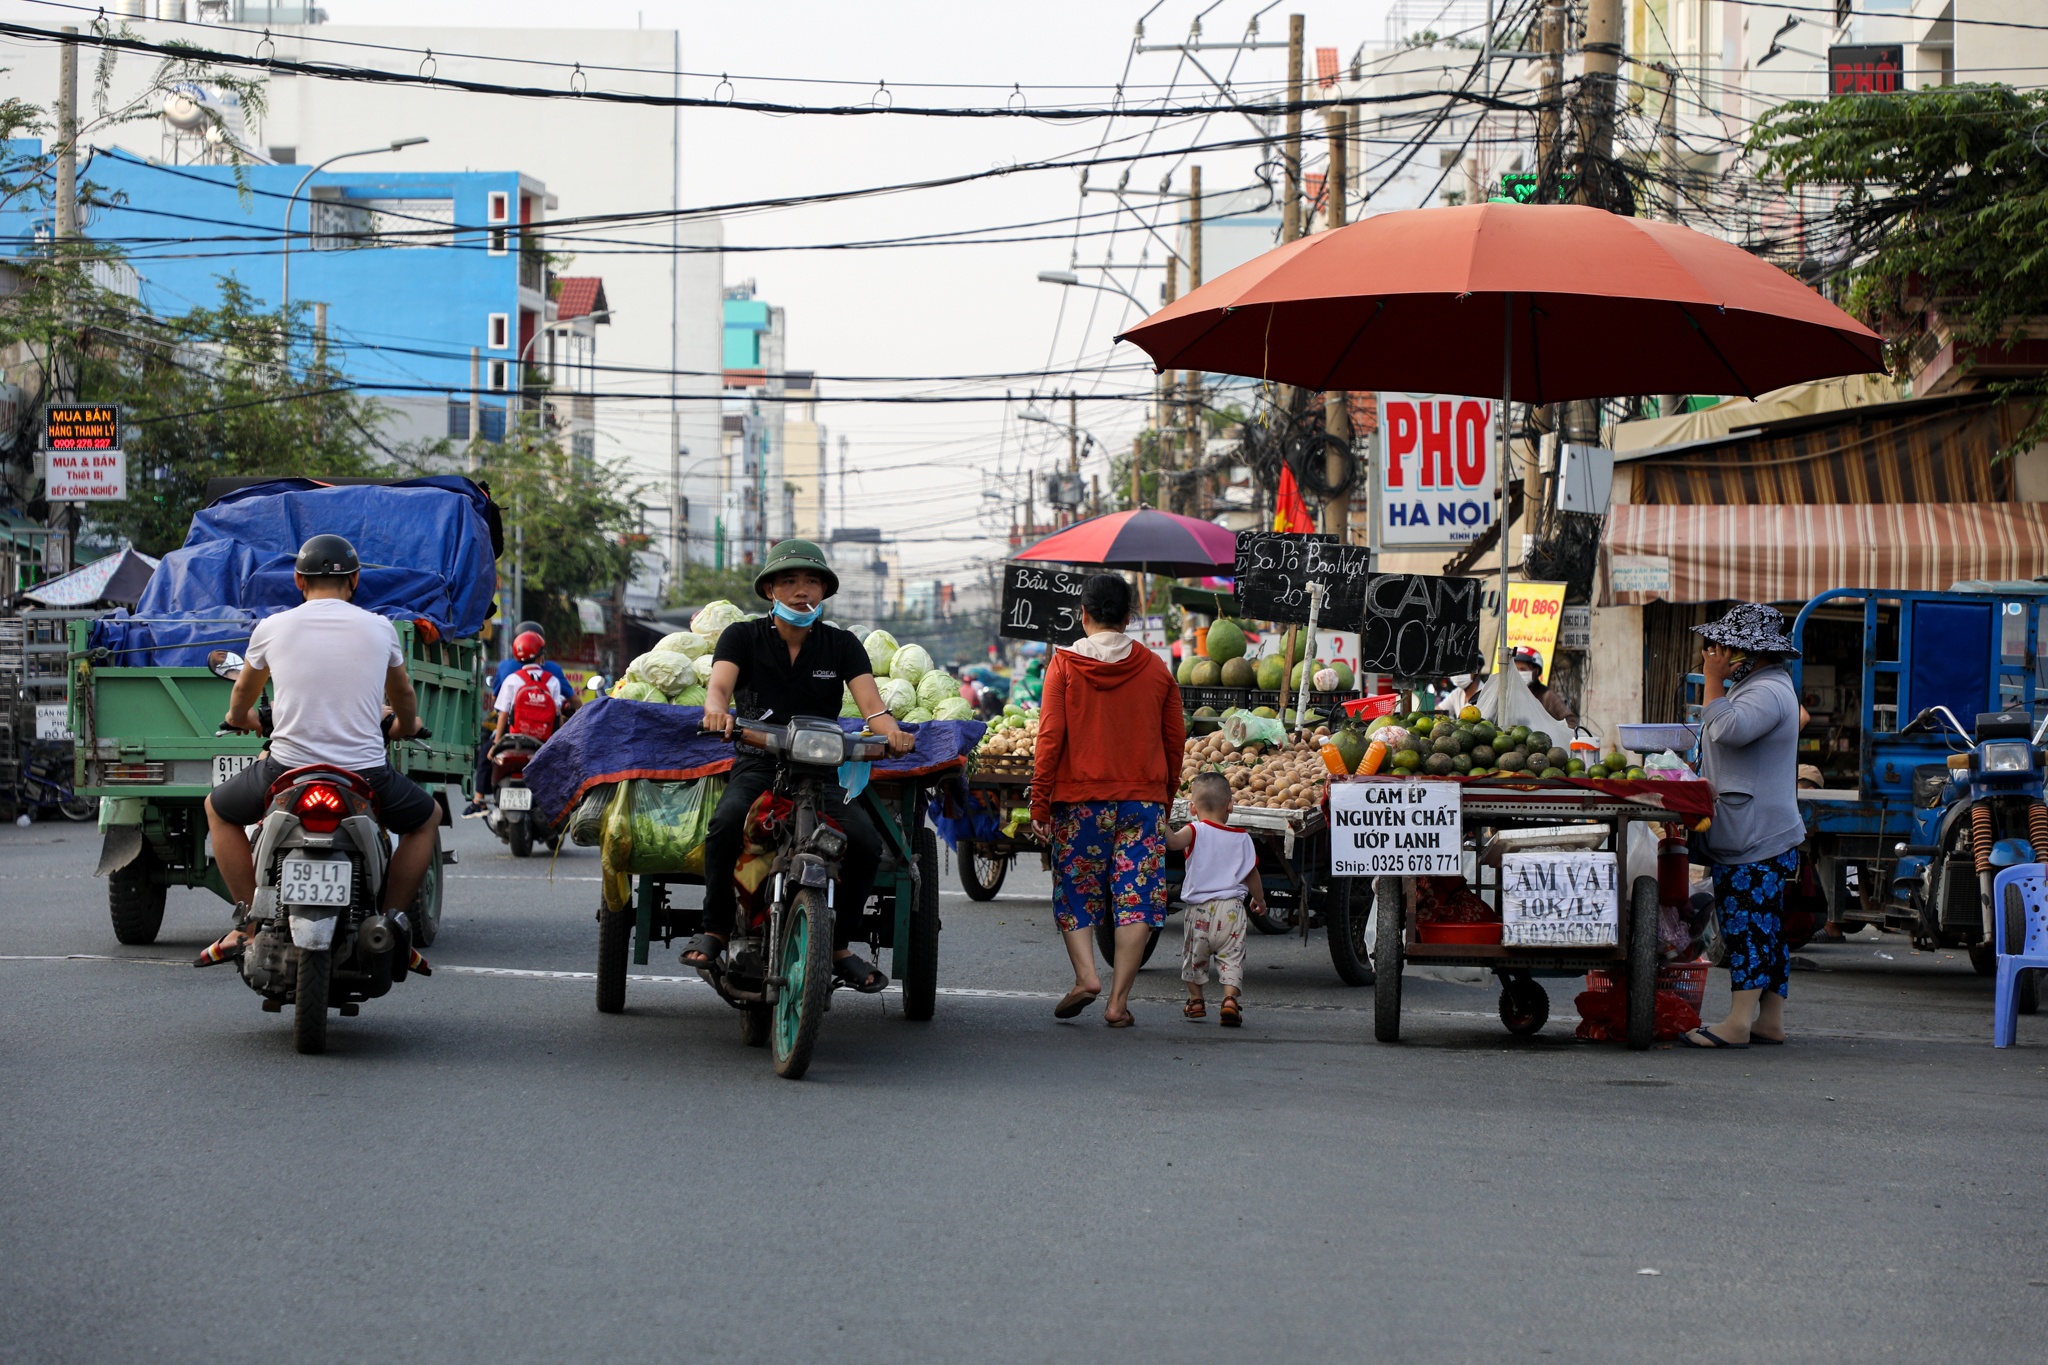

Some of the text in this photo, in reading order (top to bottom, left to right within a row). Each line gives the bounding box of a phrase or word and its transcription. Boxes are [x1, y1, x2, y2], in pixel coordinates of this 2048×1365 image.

[1834, 50, 1898, 95] PHỞ
[53, 407, 111, 422] MUA BÁN
[48, 421, 115, 437] HÀNG THANH LÝ
[94, 439, 111, 448] 227
[53, 454, 116, 467] MUA & BÁN
[68, 484, 89, 496] CÔNG
[1389, 498, 1491, 529] HÀ NỘI
[1305, 542, 1336, 573] Bao
[1016, 569, 1048, 590] Bầu
[1367, 574, 1476, 621] CAM
[1532, 599, 1559, 620] BBQ
[1365, 783, 1427, 804] CAM ÉP
[1335, 804, 1458, 826] NGUYÊN CHẤT
[1353, 829, 1440, 853] ƯỚP LẠNH
[293, 863, 339, 882] 59-L1
[1335, 854, 1459, 874] Ship: 0325 678 771
[1502, 862, 1558, 893] CAM
[285, 883, 346, 902] 253.23
